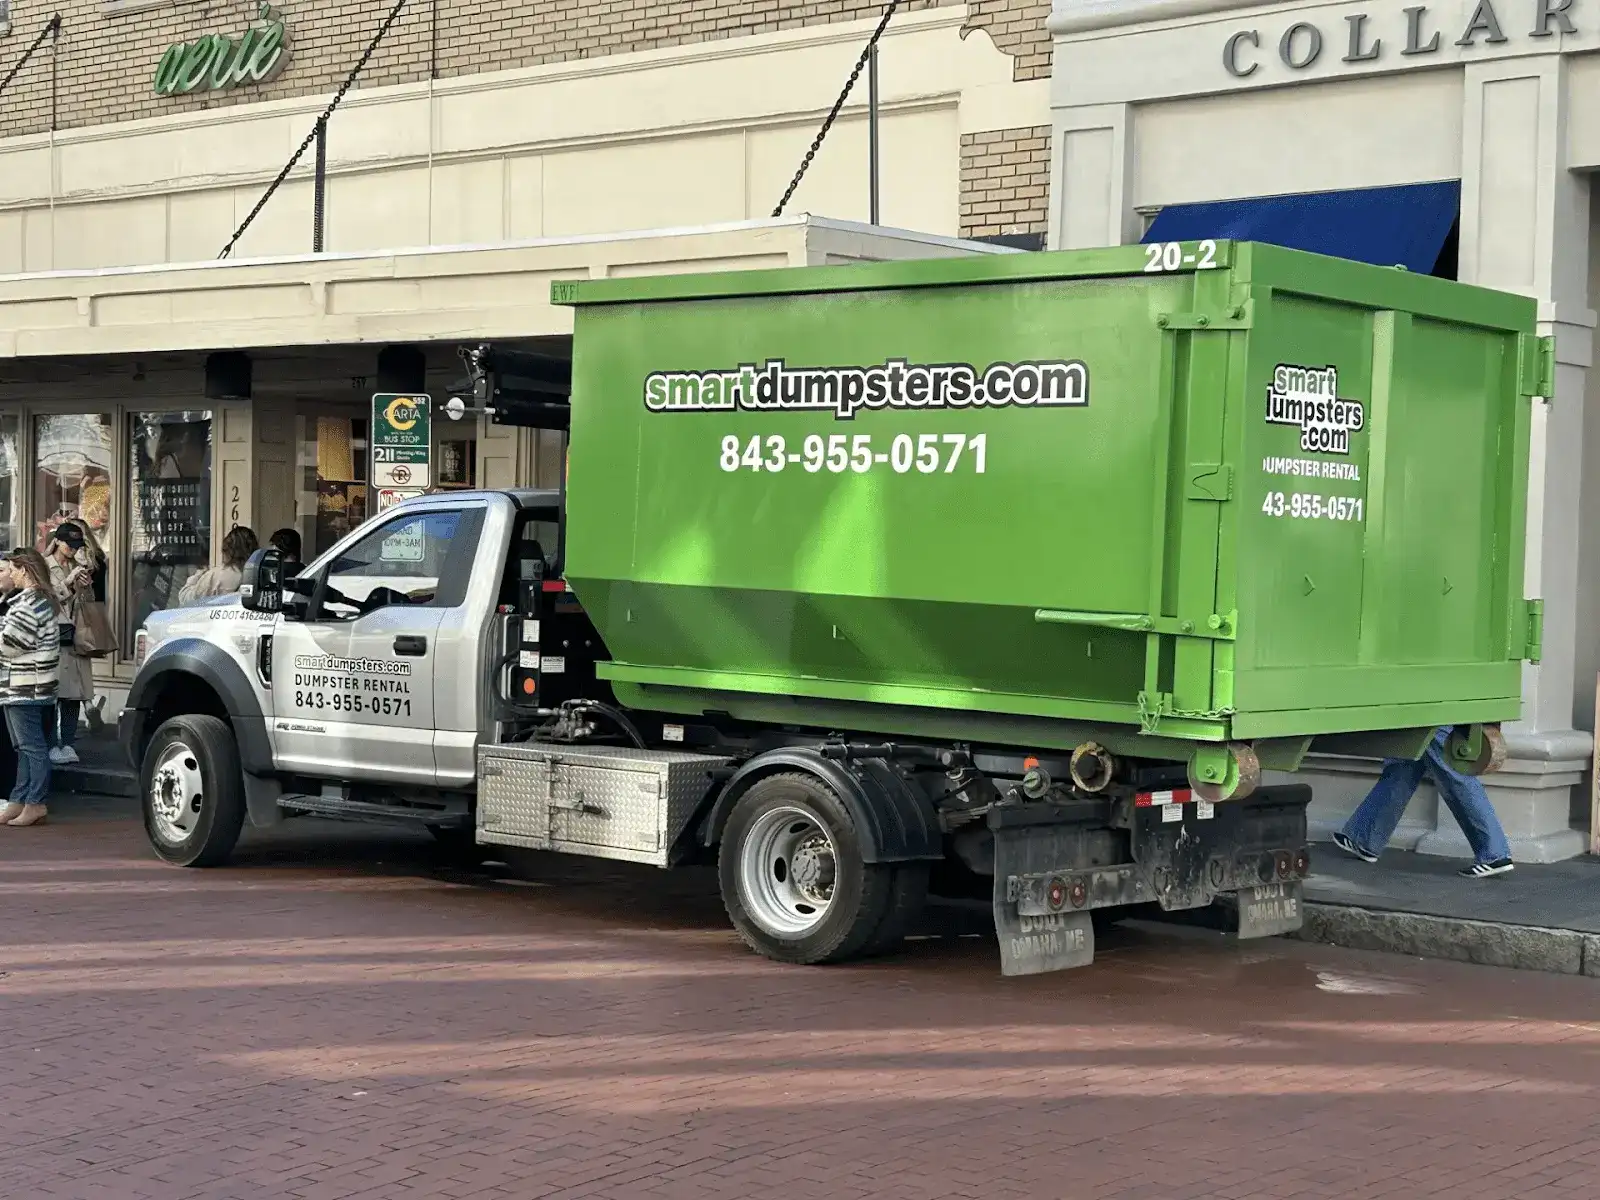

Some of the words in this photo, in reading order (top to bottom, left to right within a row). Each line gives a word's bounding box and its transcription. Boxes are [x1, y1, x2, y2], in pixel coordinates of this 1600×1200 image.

[154, 3, 285, 95] aerie
[1222, 0, 1577, 77] COLLAR
[1143, 239, 1217, 272] 20-2
[646, 359, 1088, 419] smartdumpsters.com
[1275, 367, 1336, 396] smart
[384, 435, 398, 443] BUS
[400, 435, 420, 443] STOP
[1302, 426, 1347, 450] .com
[374, 447, 395, 461] 211
[719, 433, 987, 474] 843-955-0571
[1262, 456, 1320, 478] UMPSTER
[1322, 460, 1361, 481] RENTAL
[1262, 491, 1363, 522] 43-955-0571
[209, 610, 221, 620] US
[222, 610, 240, 620] DOT
[295, 655, 411, 675] smartdumpsters.com
[295, 674, 360, 690] DUMPSTER
[363, 679, 410, 694] RENTAL
[295, 691, 411, 717] 843-955-0571
